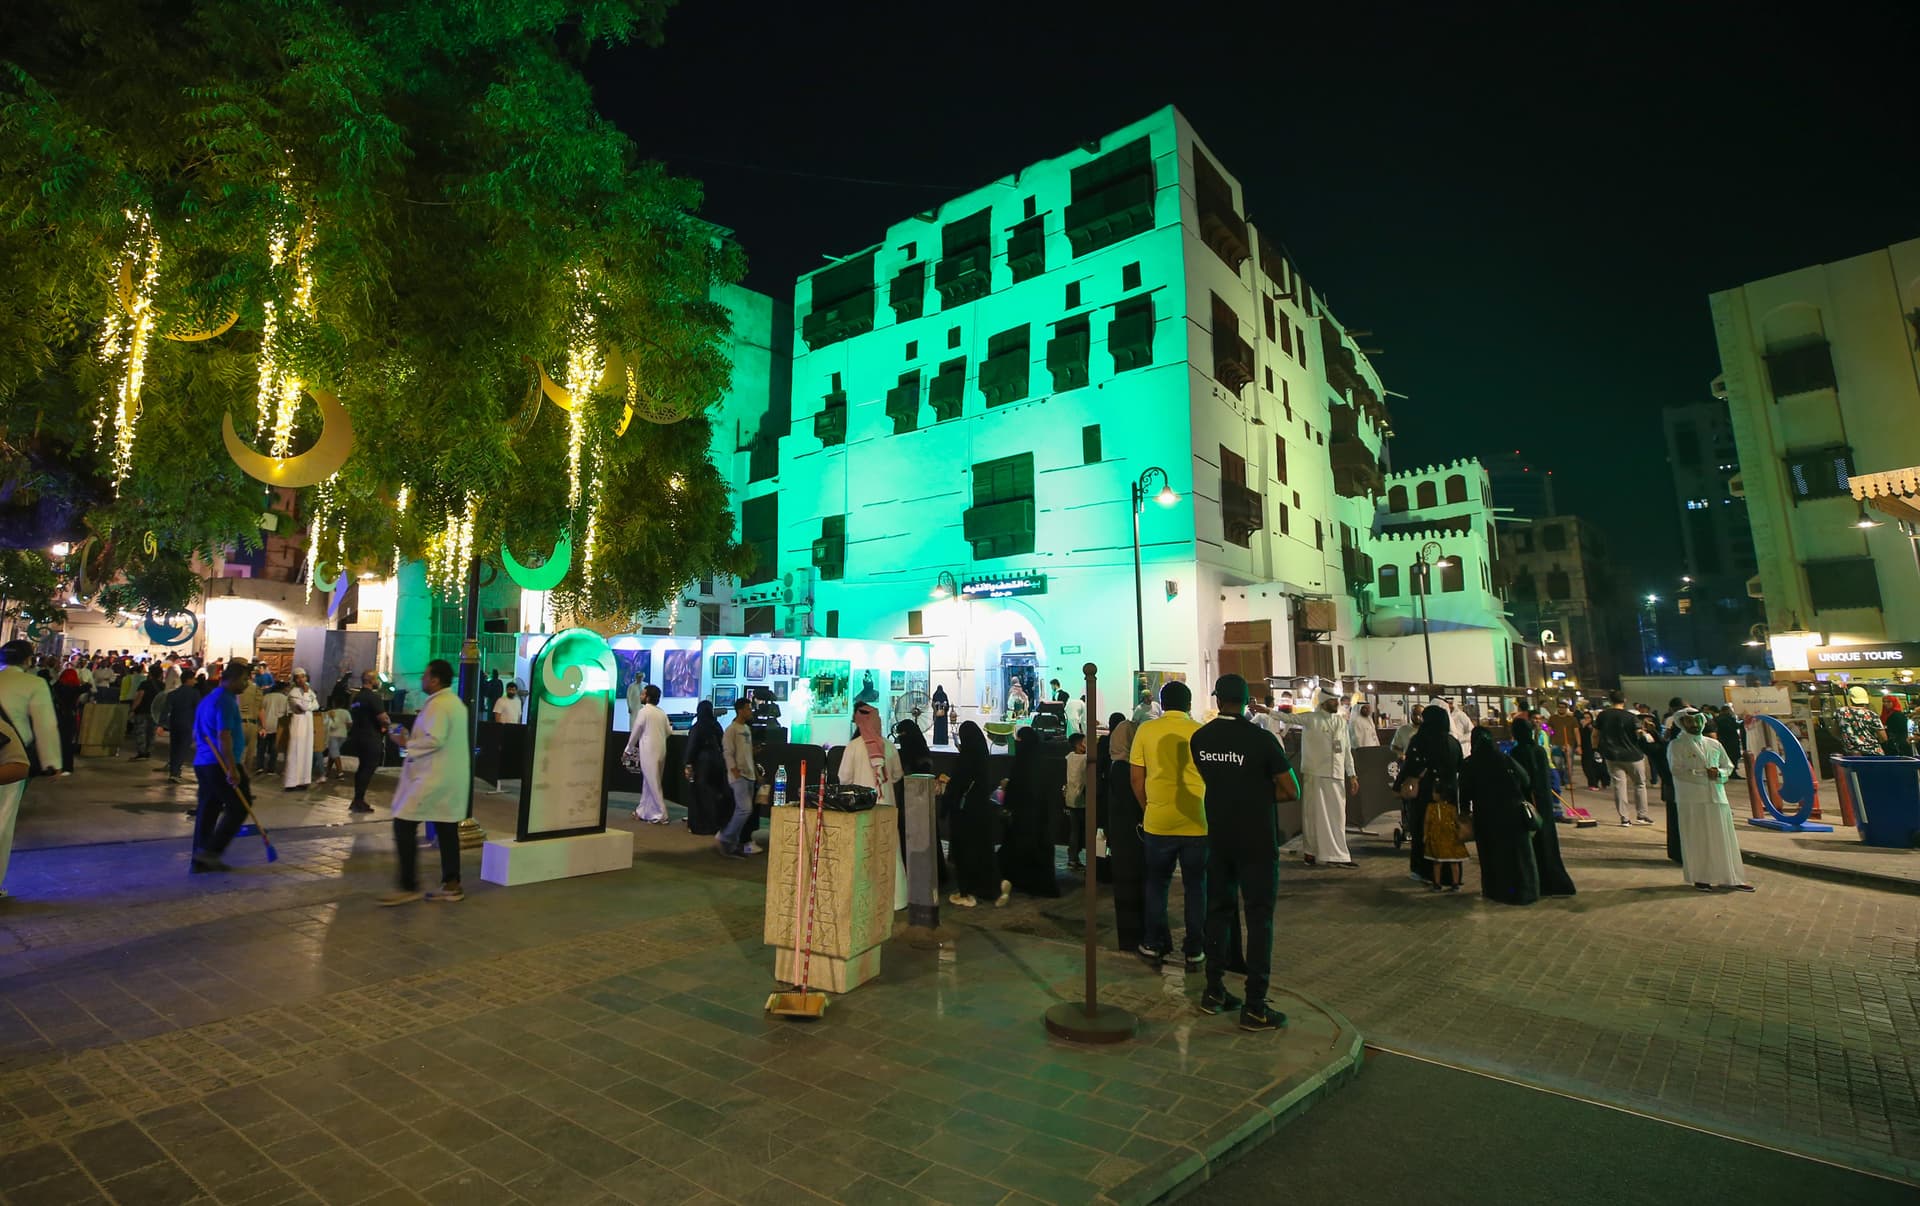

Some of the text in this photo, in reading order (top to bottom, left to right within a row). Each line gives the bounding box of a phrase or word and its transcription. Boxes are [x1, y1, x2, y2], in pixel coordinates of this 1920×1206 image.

[1818, 651, 1903, 662] UNIQUE TOURS
[1199, 750, 1244, 766] Security
